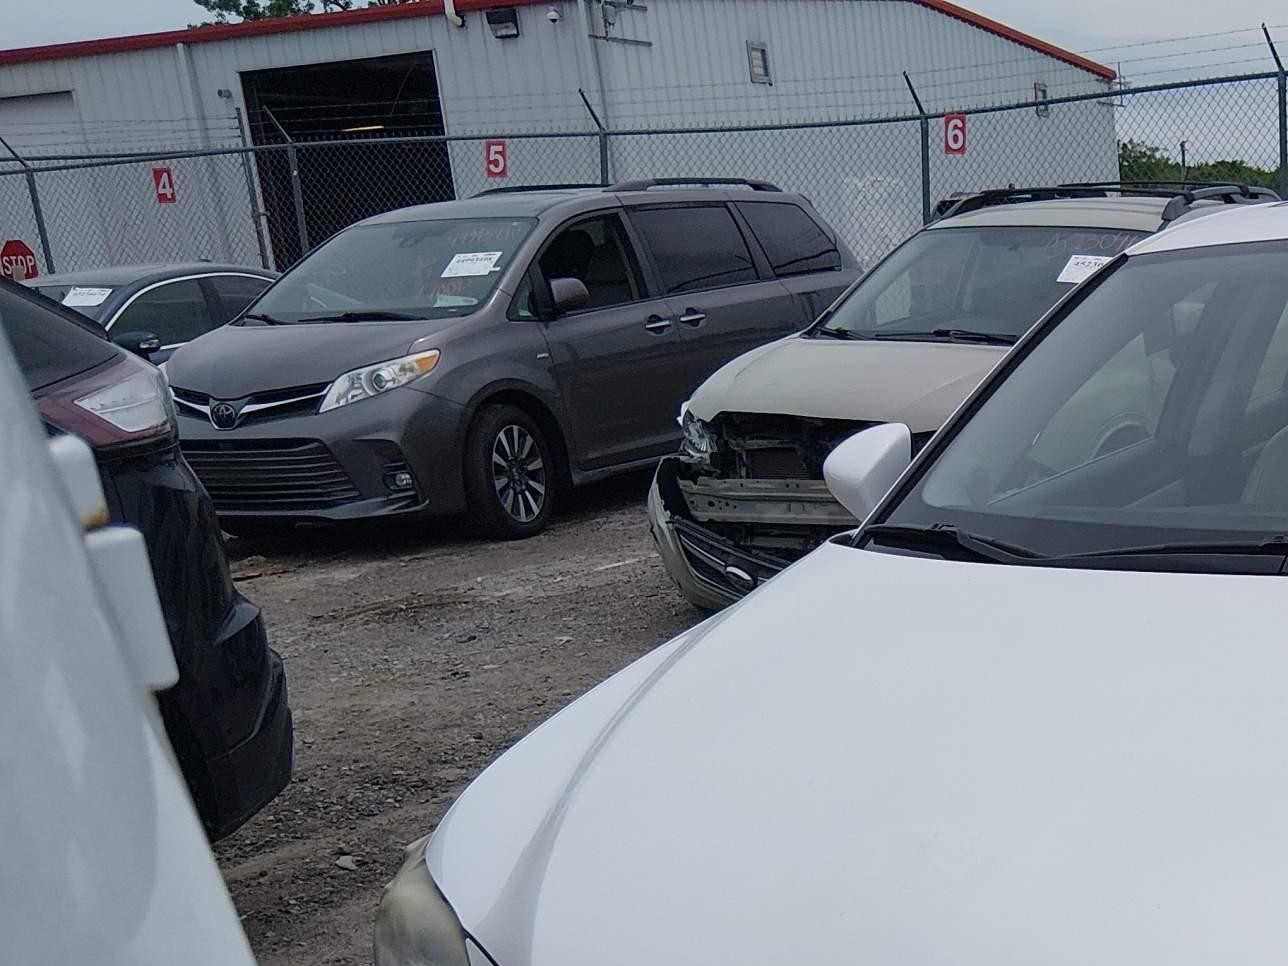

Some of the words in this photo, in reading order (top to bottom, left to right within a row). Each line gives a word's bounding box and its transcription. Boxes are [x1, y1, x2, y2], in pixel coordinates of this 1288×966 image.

[947, 118, 964, 150] 6
[488, 144, 505, 174] 5
[158, 171, 173, 199] 4
